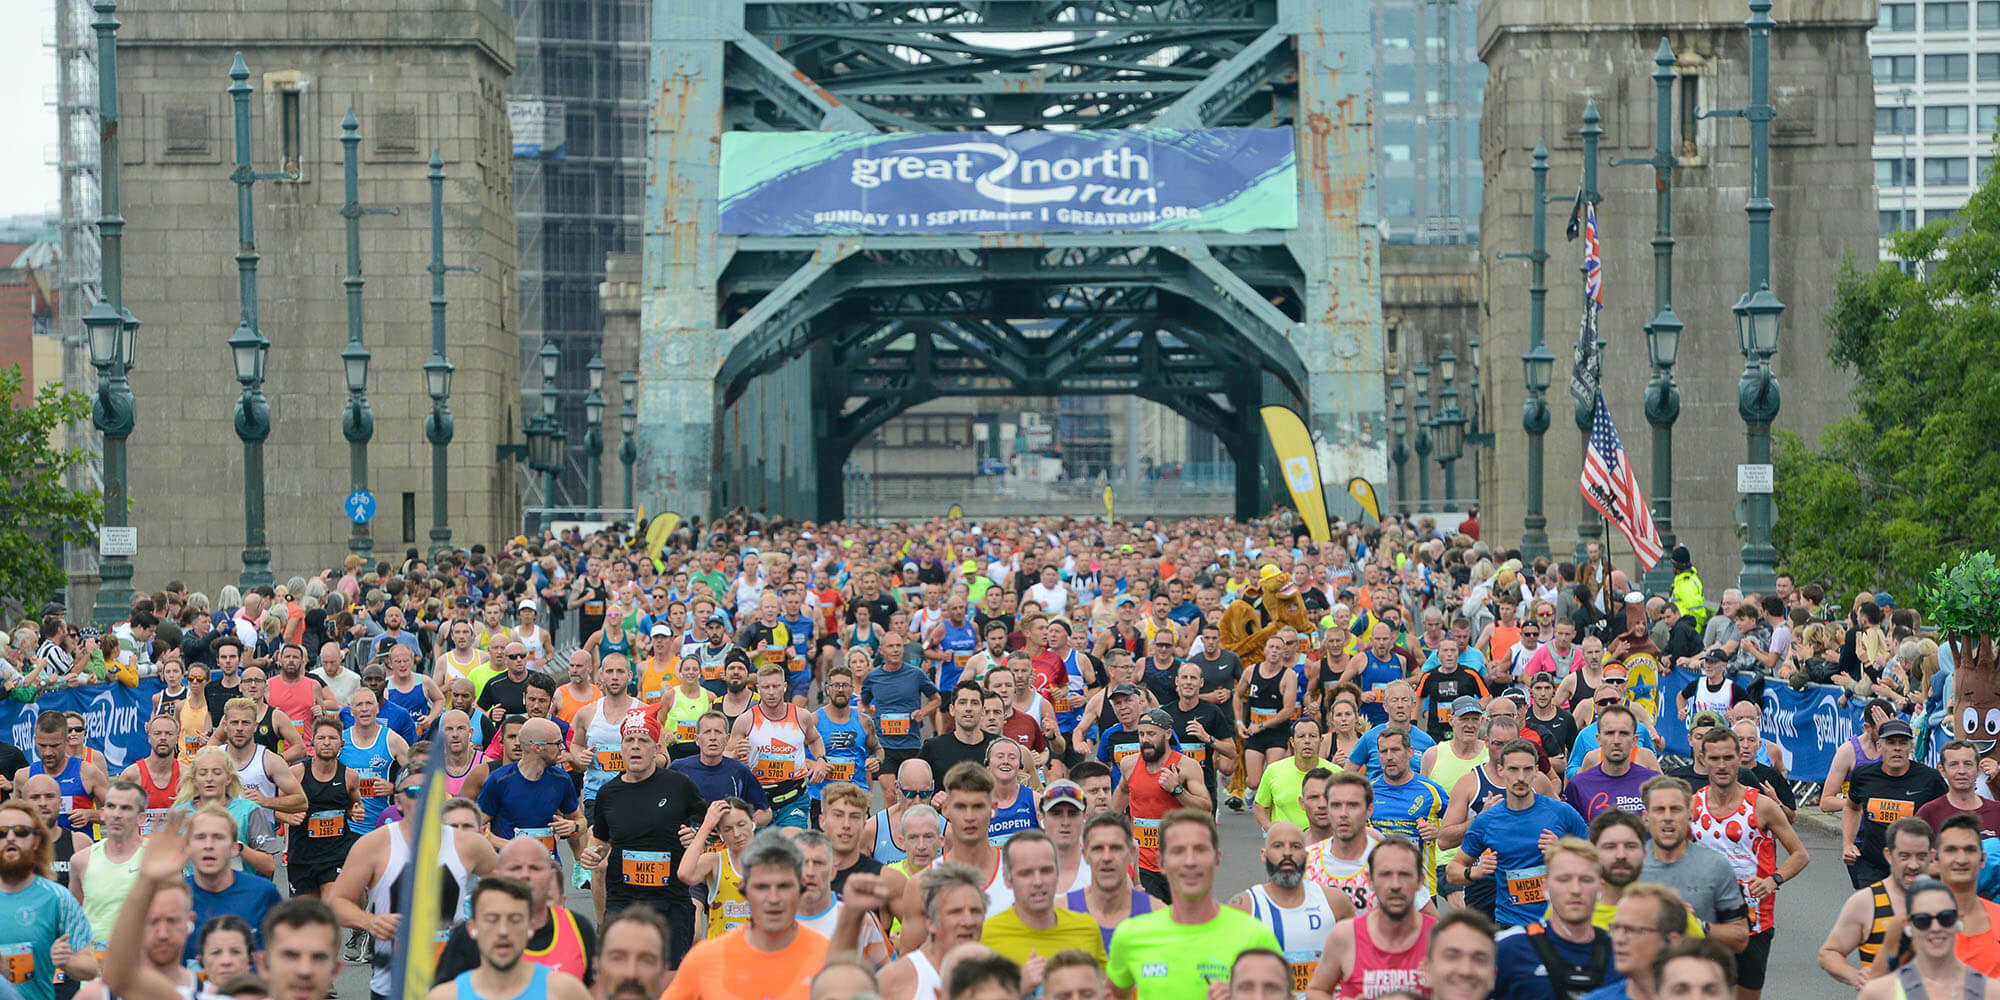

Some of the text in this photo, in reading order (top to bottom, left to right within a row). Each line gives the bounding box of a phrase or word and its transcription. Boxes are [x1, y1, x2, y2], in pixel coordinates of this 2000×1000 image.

[851, 147, 1149, 189] great north
[1079, 184, 1157, 206] run
[813, 209, 889, 226] SUNDAY
[897, 213, 920, 226] 11
[926, 208, 1033, 225] SEPTEMBER
[1056, 206, 1201, 226] GREATRUN.ORG
[114, 705, 138, 735] run
[1779, 709, 1798, 738] run
[12, 713, 33, 751] great
[1813, 706, 1835, 751] great
[771, 745, 795, 754] Society
[1880, 801, 1901, 811] MARK
[987, 819, 1031, 833] MORPETH
[1144, 838, 1159, 846] 371
[636, 863, 656, 872] MIKE
[635, 874, 655, 884] 3911
[1309, 914, 1321, 930] D
[1143, 964, 1167, 976] NHS
